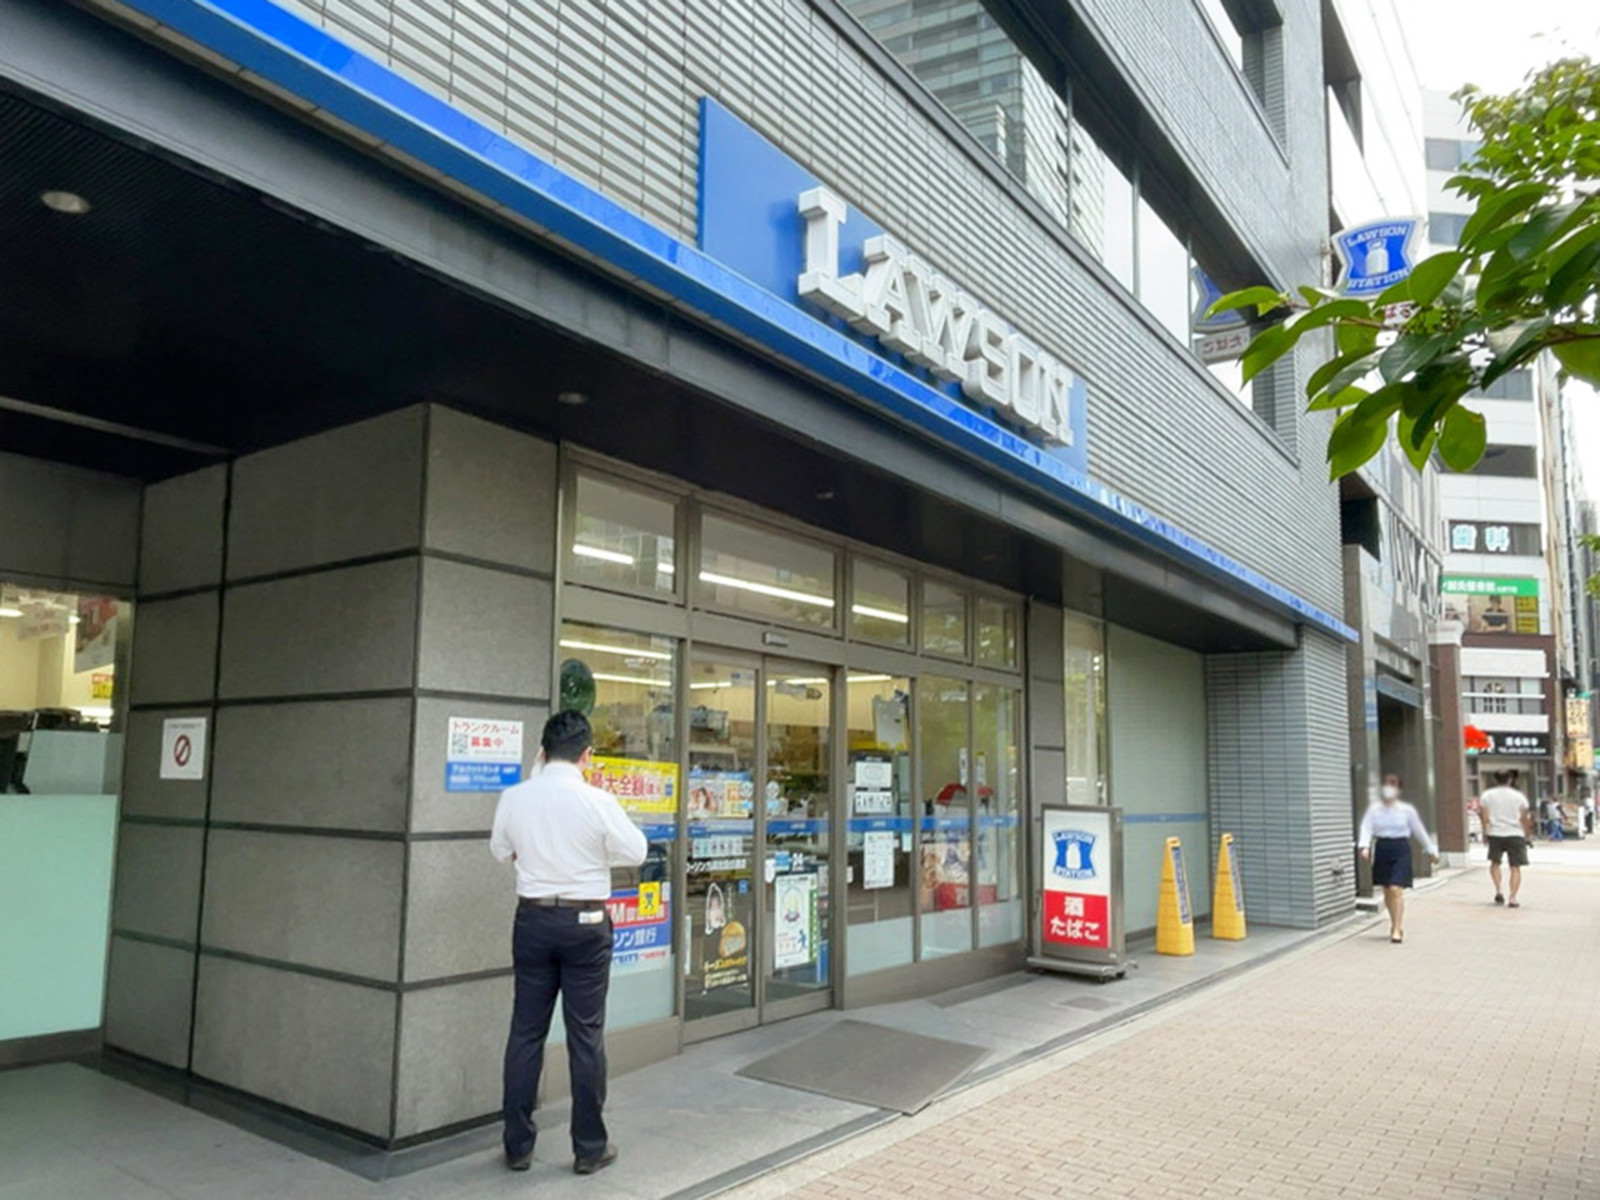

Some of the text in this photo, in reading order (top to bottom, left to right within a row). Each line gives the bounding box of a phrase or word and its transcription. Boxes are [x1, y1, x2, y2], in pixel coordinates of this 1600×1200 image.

[1346, 225, 1407, 247] LAWSON
[1349, 267, 1411, 290] STATION
[798, 187, 1073, 446] LAWSON
[1452, 525, 1510, 551] 歯科
[453, 722, 519, 735] トランクルーム
[471, 736, 504, 748] 募集中
[1054, 831, 1094, 844] LAWSON
[1055, 866, 1094, 878] STATION
[1064, 896, 1084, 917] 酒
[1050, 916, 1099, 940] たばこ
